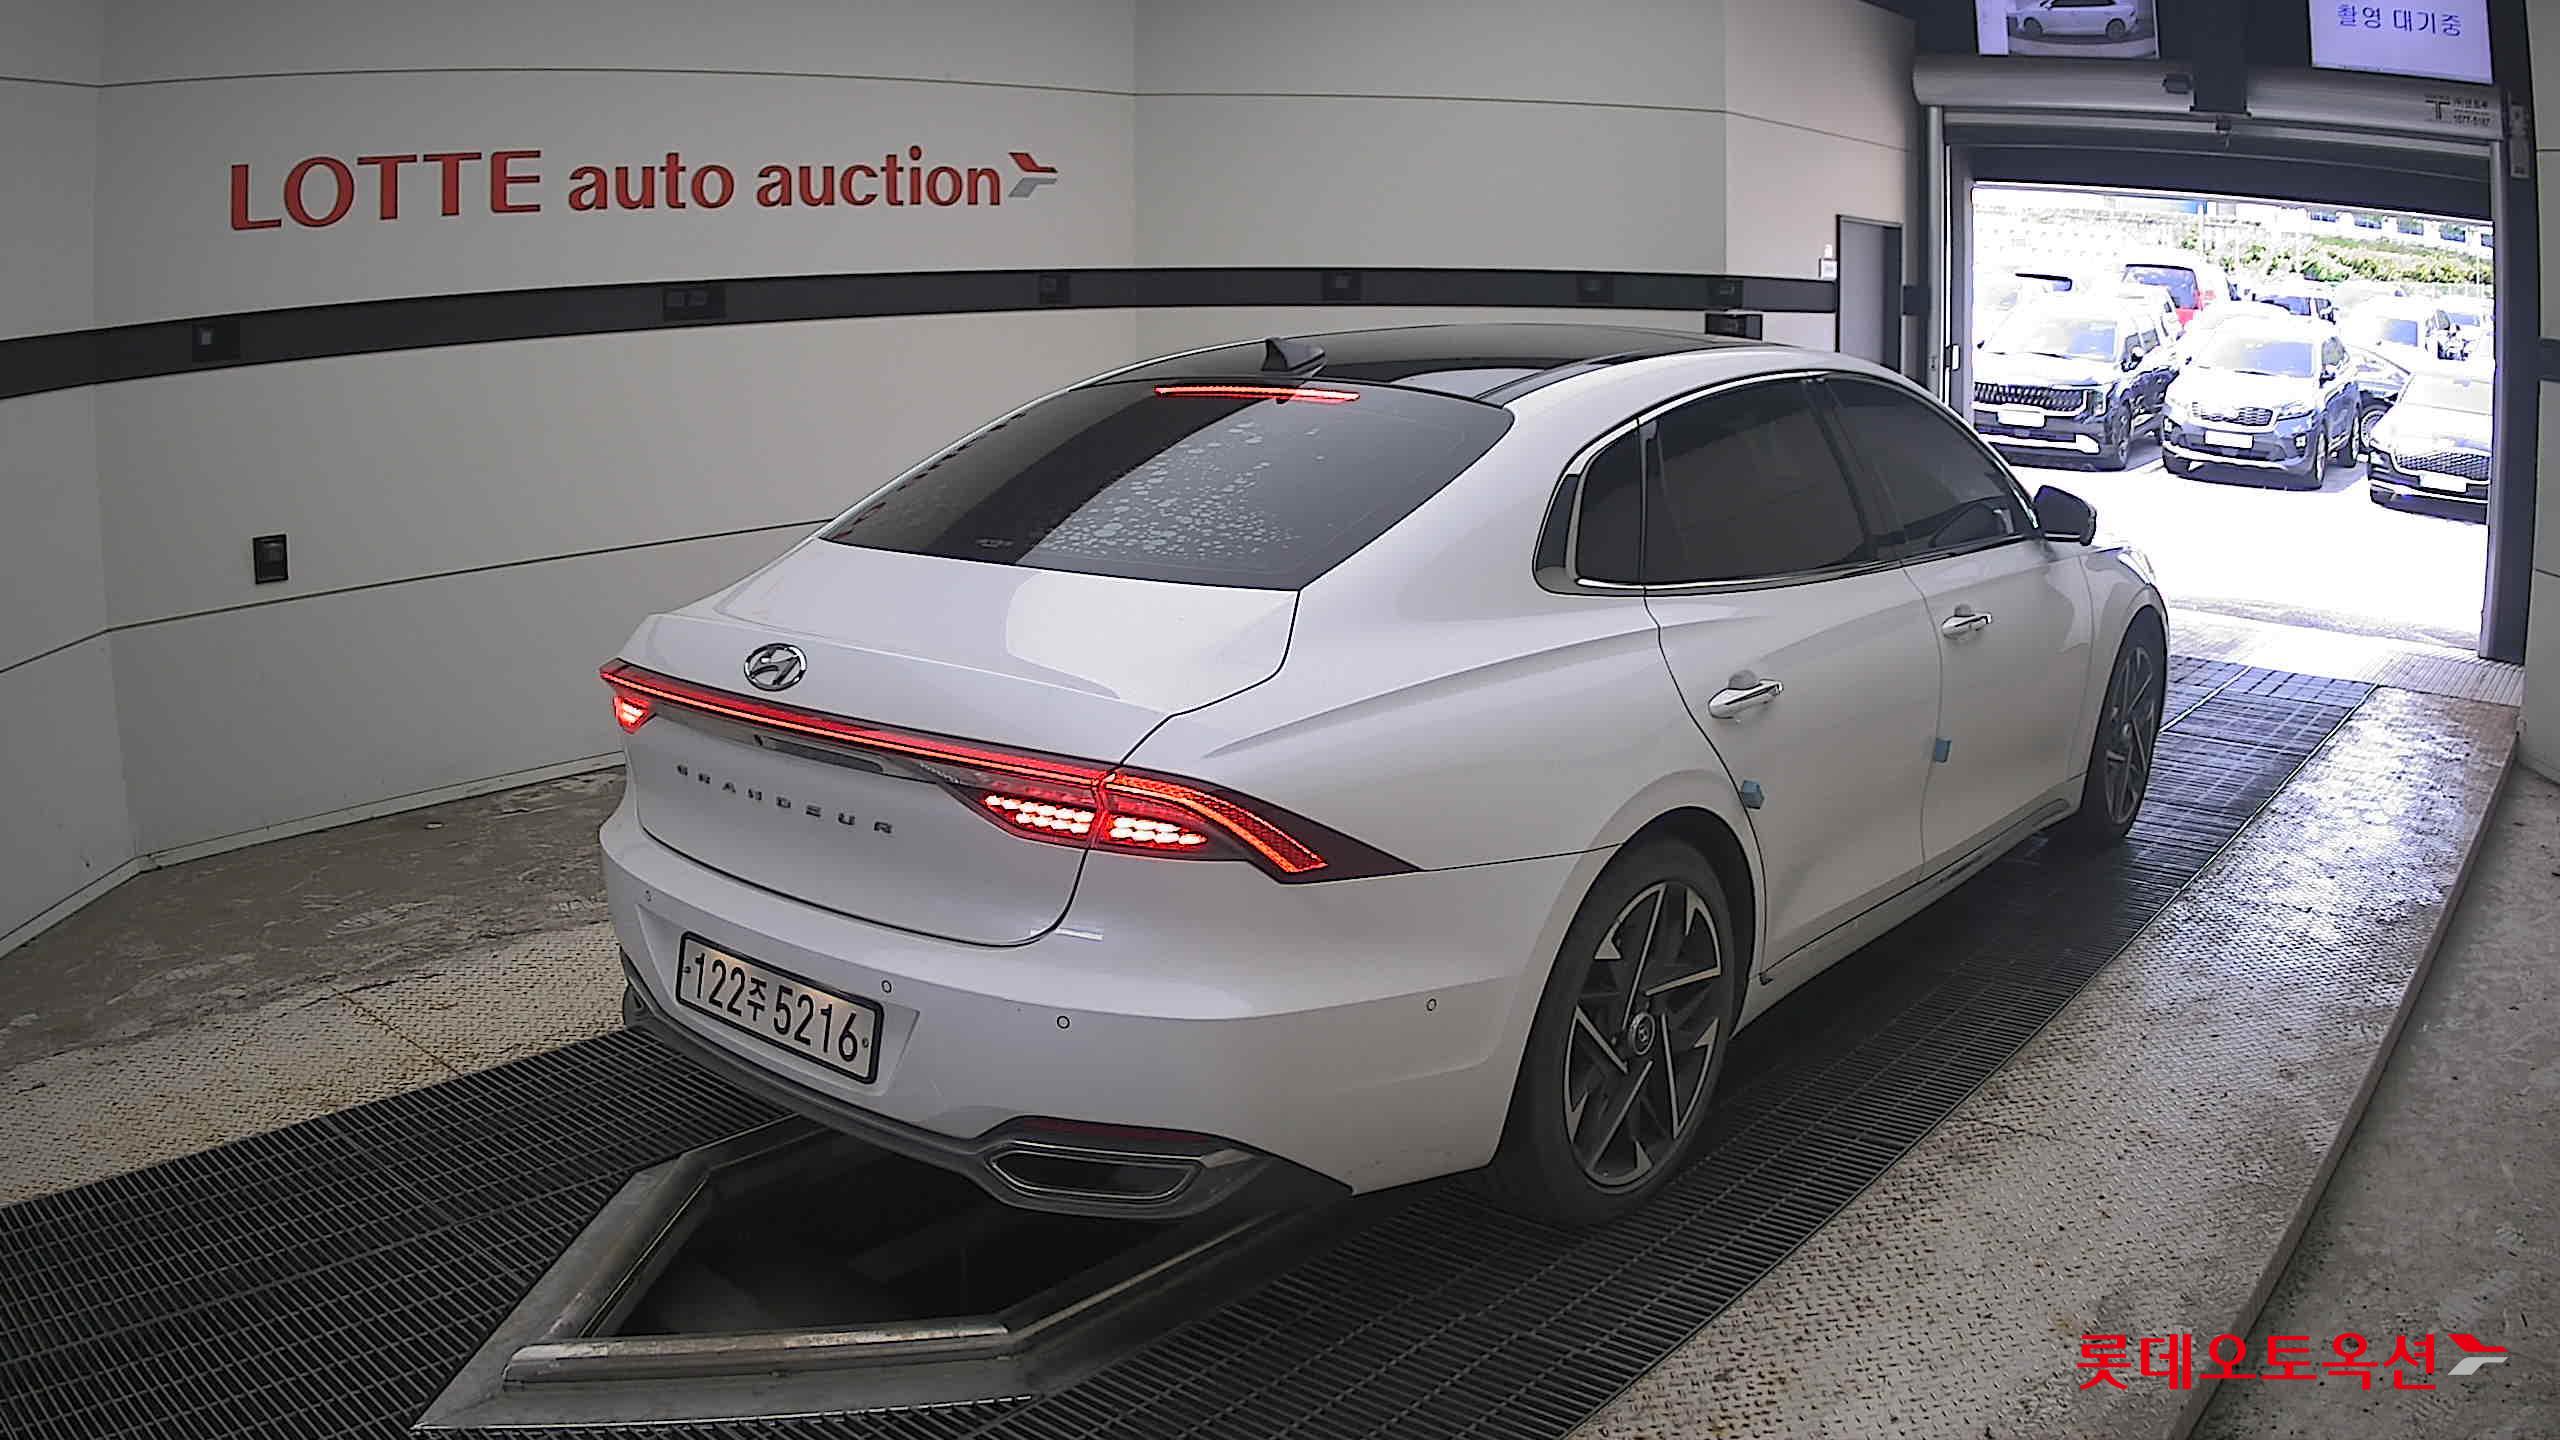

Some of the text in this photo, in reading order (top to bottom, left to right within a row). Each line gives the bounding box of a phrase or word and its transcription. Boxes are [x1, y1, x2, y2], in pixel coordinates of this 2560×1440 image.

[2338, 4, 2462, 37] 촬영 대기중
[230, 145, 1001, 232] LOTTE auto auction
[676, 764, 893, 834] GRANDEUR
